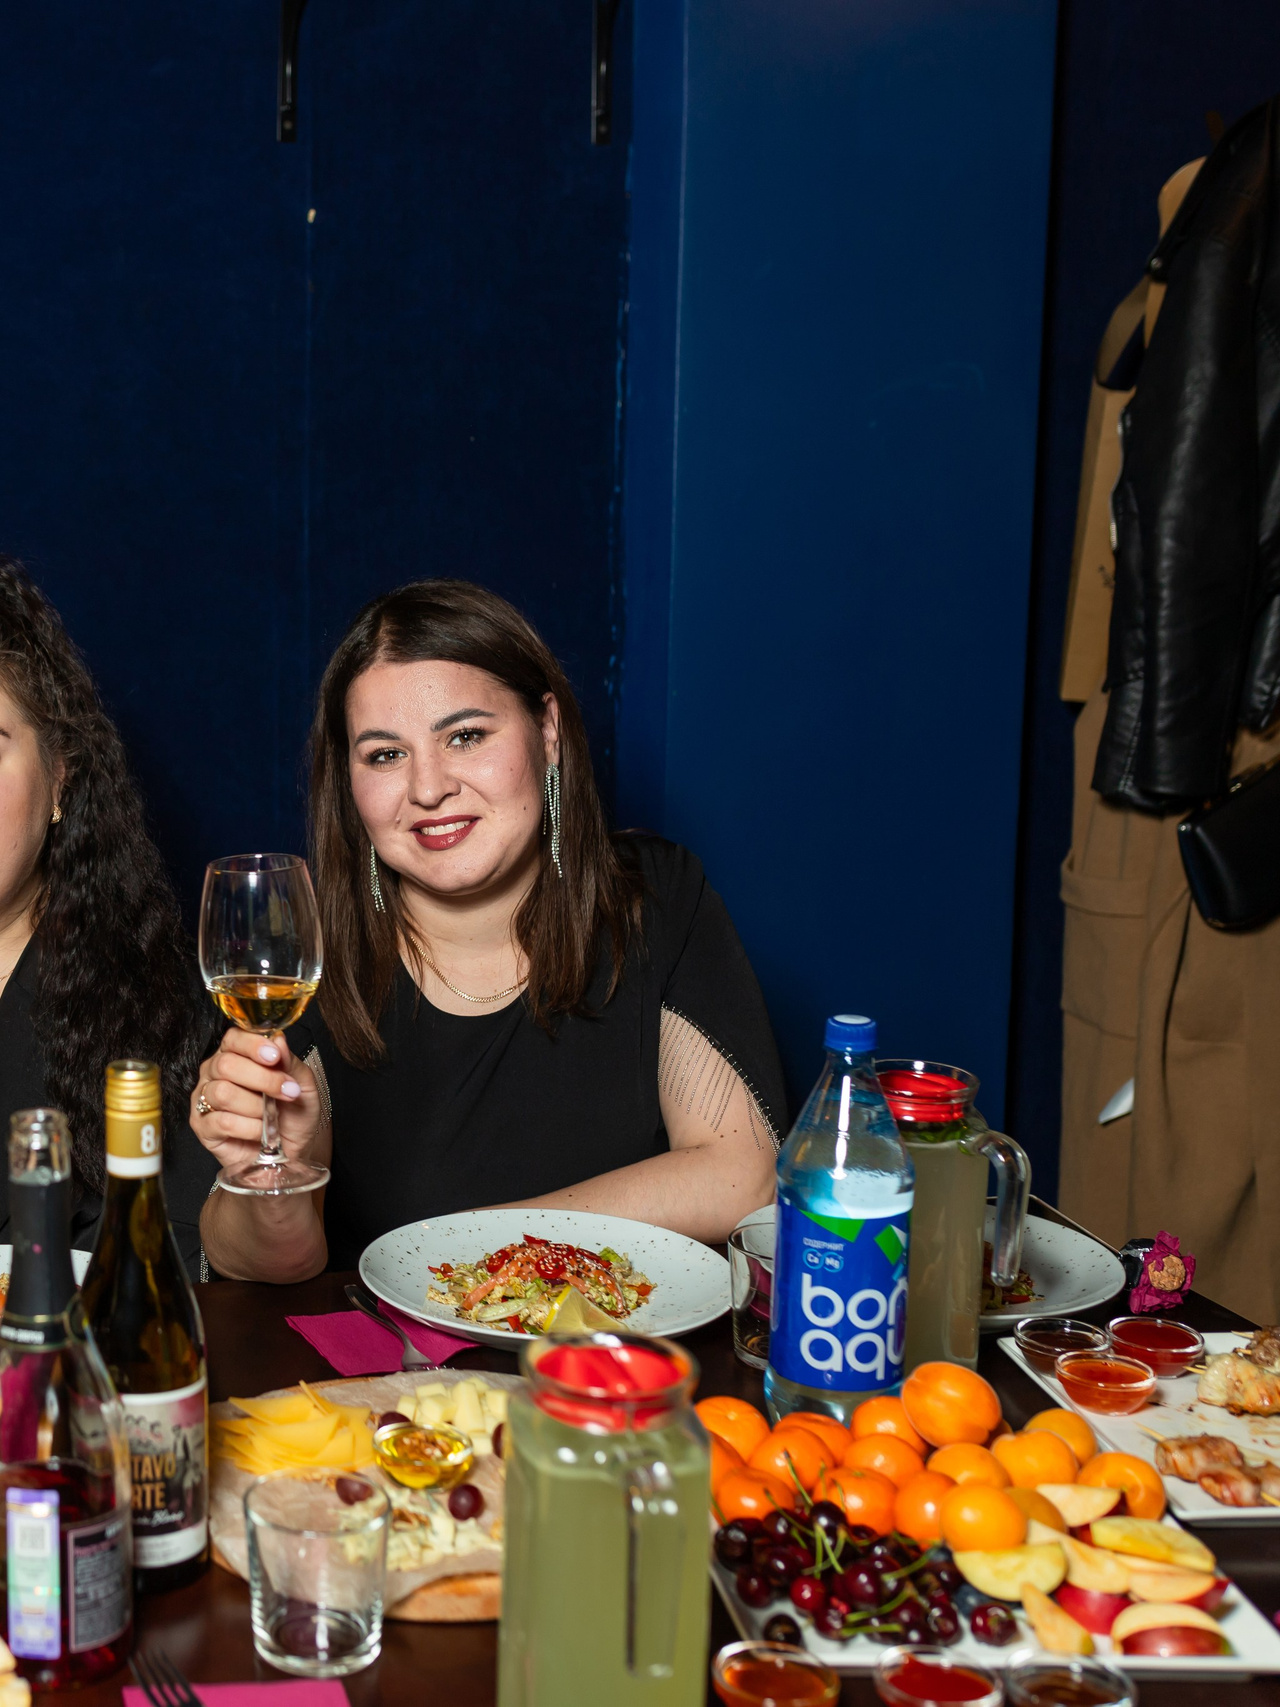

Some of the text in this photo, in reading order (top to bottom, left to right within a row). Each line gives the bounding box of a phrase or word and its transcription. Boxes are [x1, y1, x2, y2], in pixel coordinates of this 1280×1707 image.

[140, 1124, 160, 1154] 8
[799, 1328, 905, 1381] aqu
[130, 1453, 177, 1482] TAVO
[130, 1481, 167, 1510] RTE
